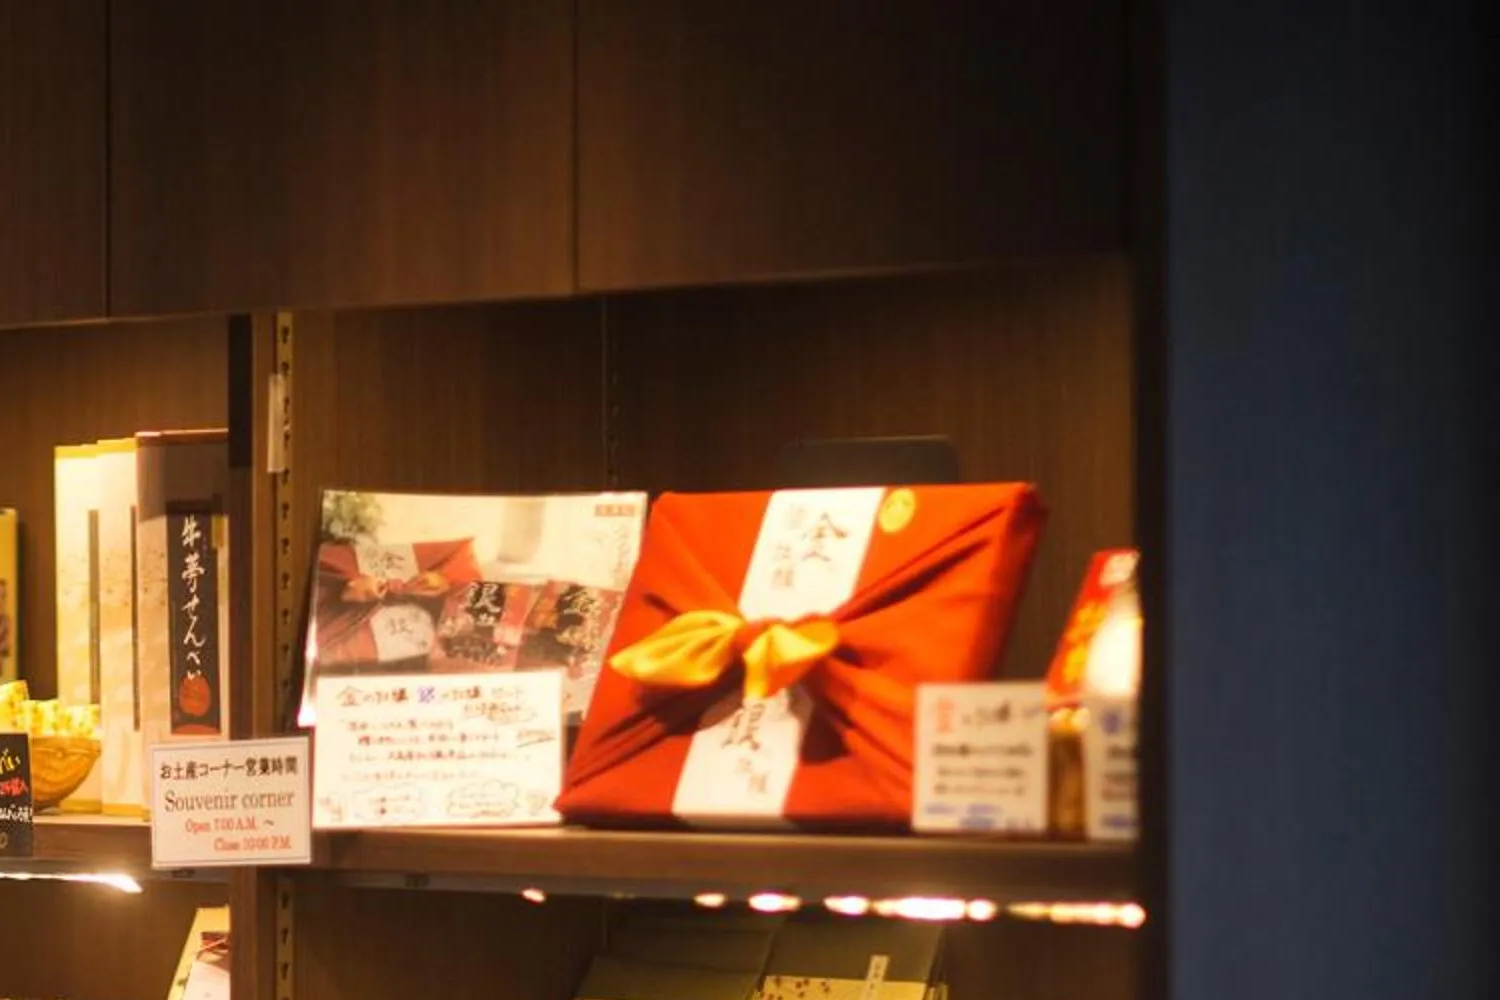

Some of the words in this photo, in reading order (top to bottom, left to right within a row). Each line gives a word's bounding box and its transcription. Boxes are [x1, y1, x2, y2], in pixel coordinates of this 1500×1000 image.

[160, 755, 298, 781] お土産コーナー営業時間
[164, 788, 239, 813] Souvenir
[241, 791, 296, 810] corner
[185, 817, 211, 834] Open
[214, 837, 240, 851] Close
